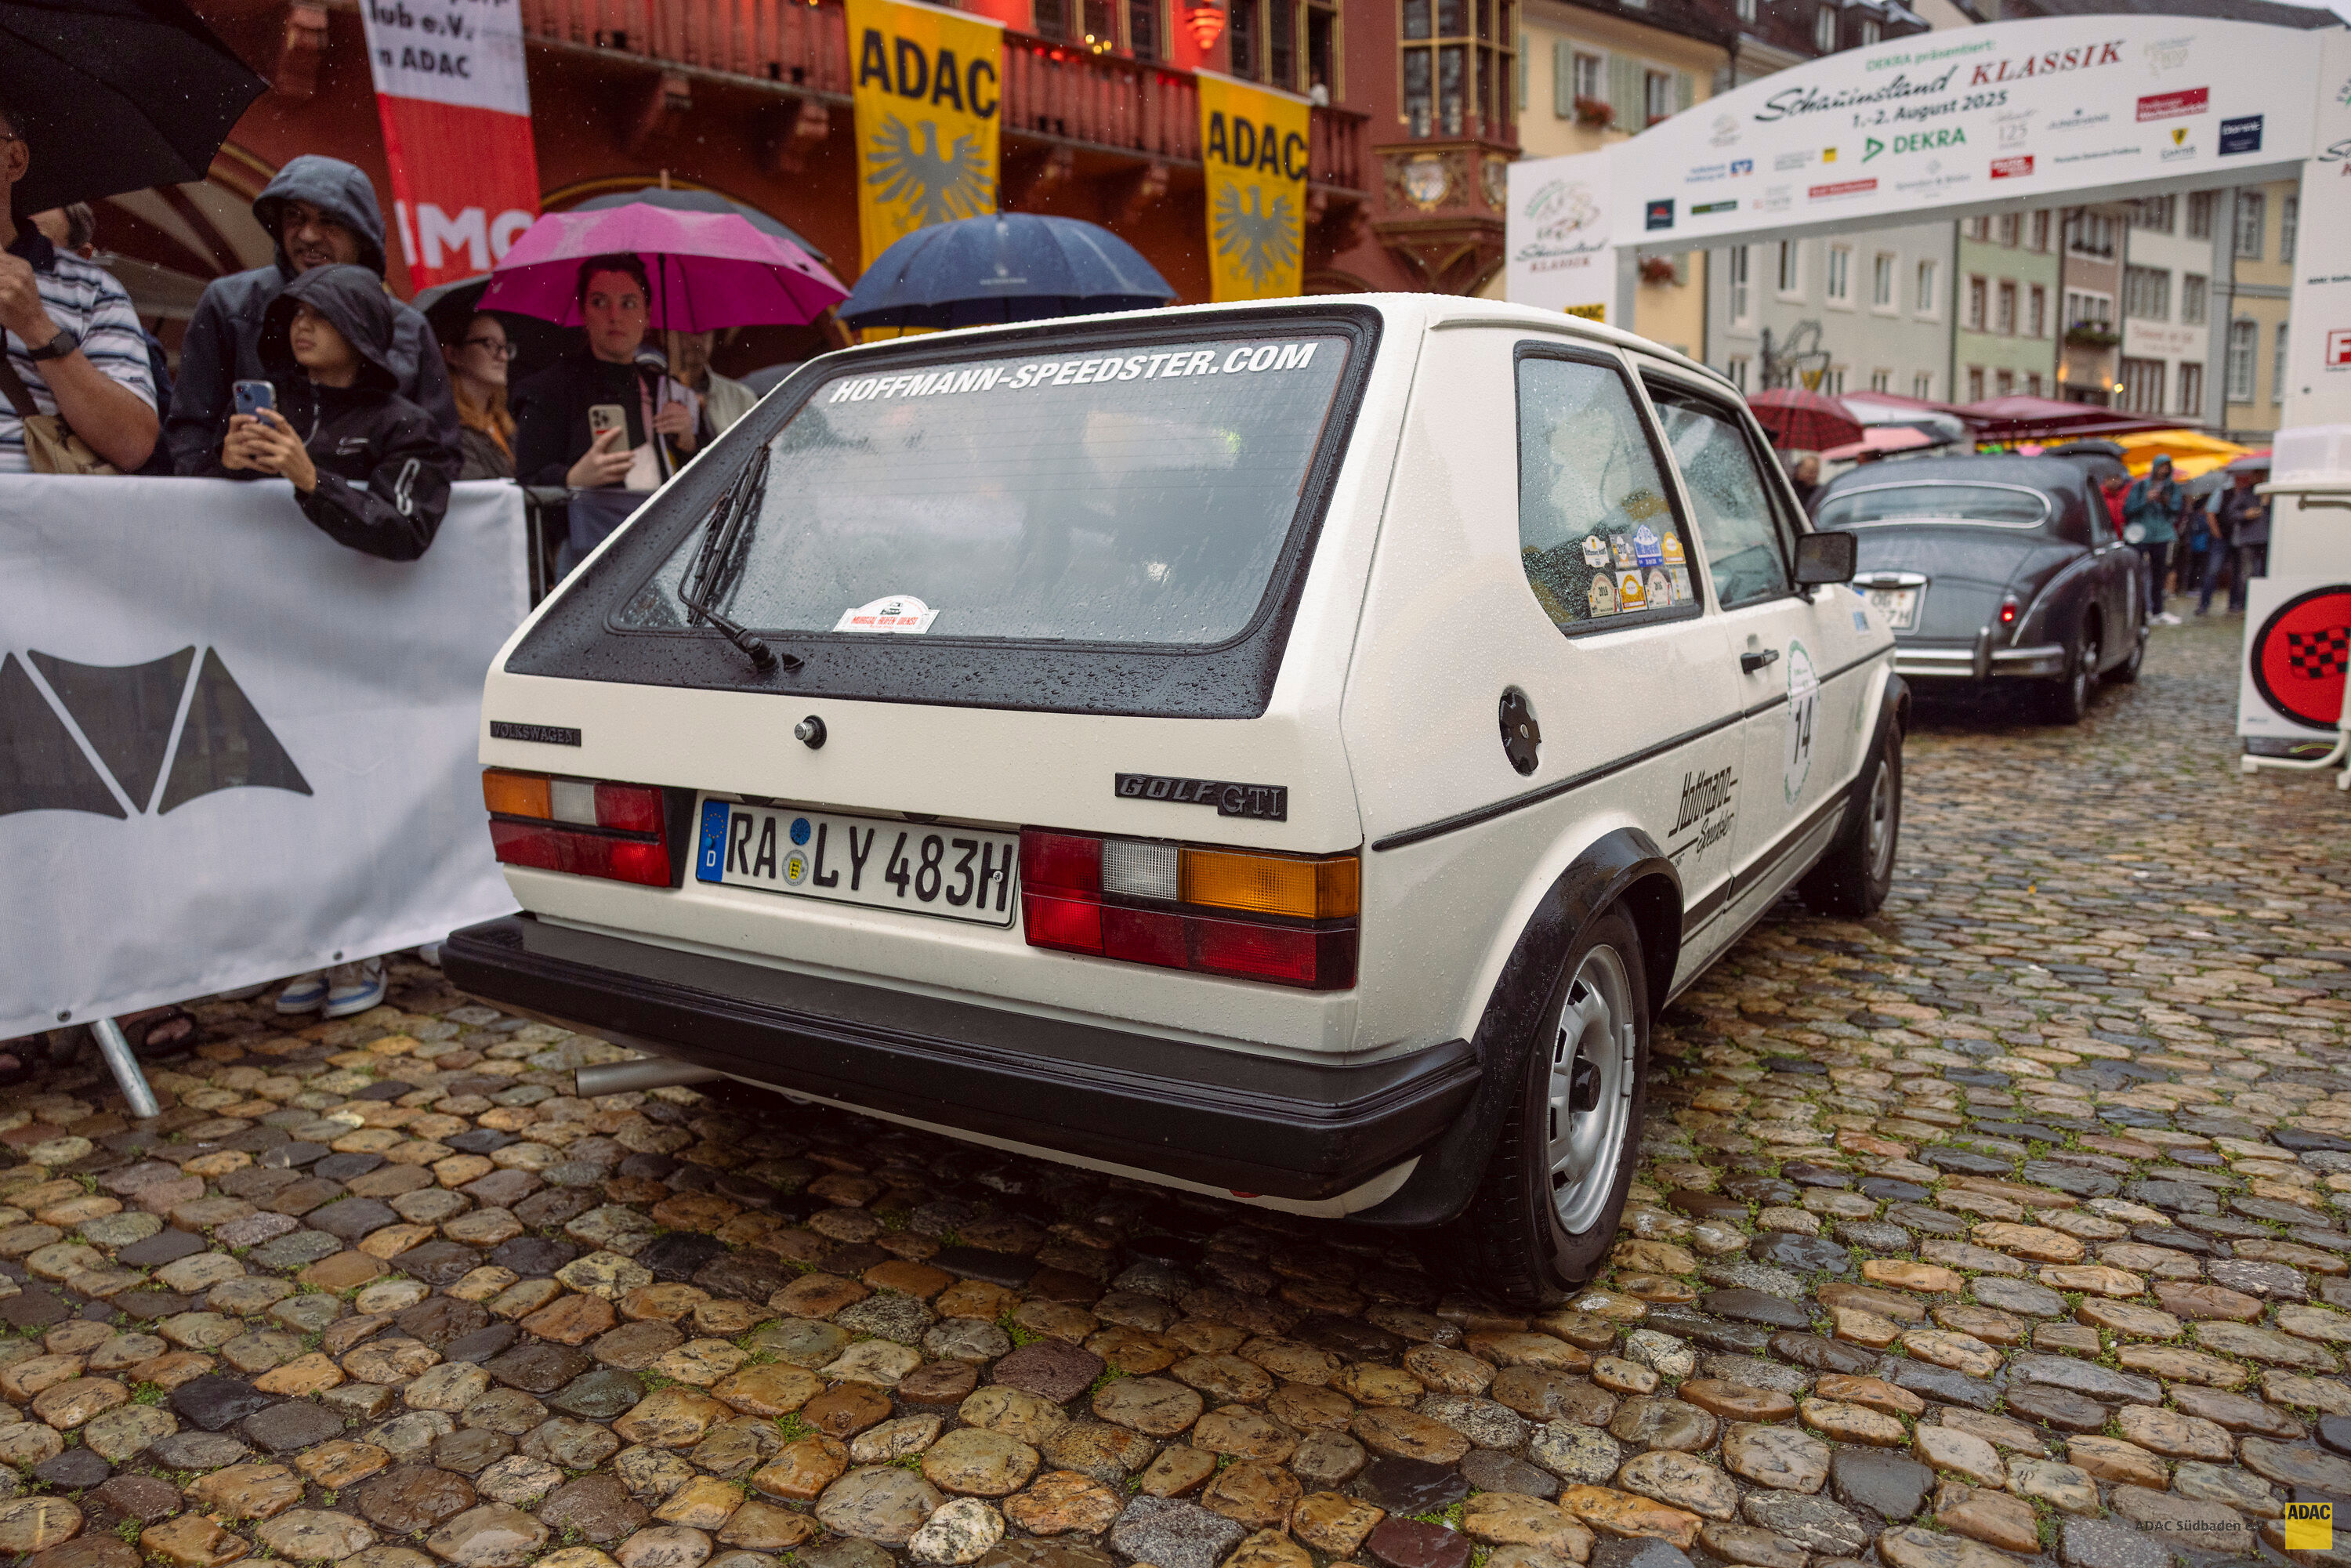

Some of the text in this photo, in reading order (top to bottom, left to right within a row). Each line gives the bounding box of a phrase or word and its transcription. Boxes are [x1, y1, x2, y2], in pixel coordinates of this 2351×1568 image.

[400, 45, 470, 78] ADAC
[860, 27, 997, 119] ADAC
[1970, 39, 2127, 87] KLASSIK
[1893, 99, 1958, 122] August
[1962, 89, 2009, 111] 2025
[1208, 111, 1309, 182] ADAC
[1893, 128, 1966, 154] DEKRA
[828, 342, 1319, 404] HOFFMANN-SPEEDSTER.COM
[494, 722, 576, 744] VOLKSWAGEN
[1793, 696, 1813, 765] 14
[1119, 776, 1281, 817] GOLF GTI
[706, 849, 716, 867] D
[726, 811, 1012, 913] RA LY 483H
